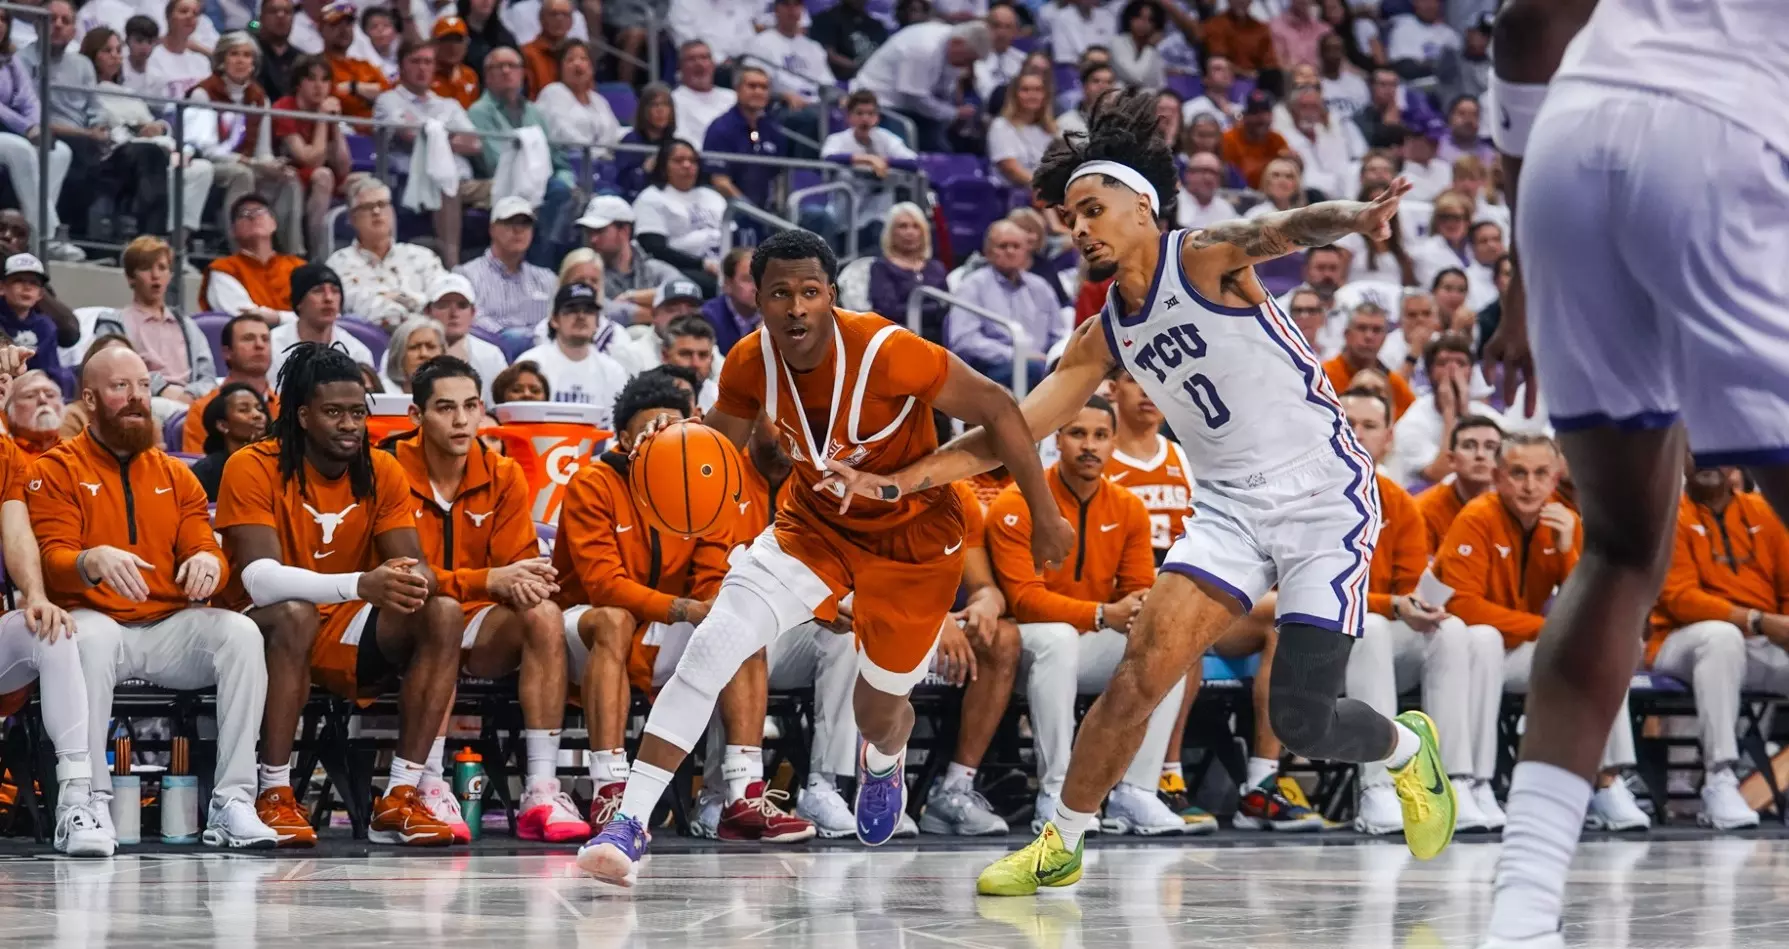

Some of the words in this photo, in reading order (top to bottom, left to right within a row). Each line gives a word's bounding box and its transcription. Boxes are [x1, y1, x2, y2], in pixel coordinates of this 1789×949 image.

[1134, 323, 1208, 385] TCU
[546, 445, 580, 485] G
[1127, 484, 1188, 510] EXAS
